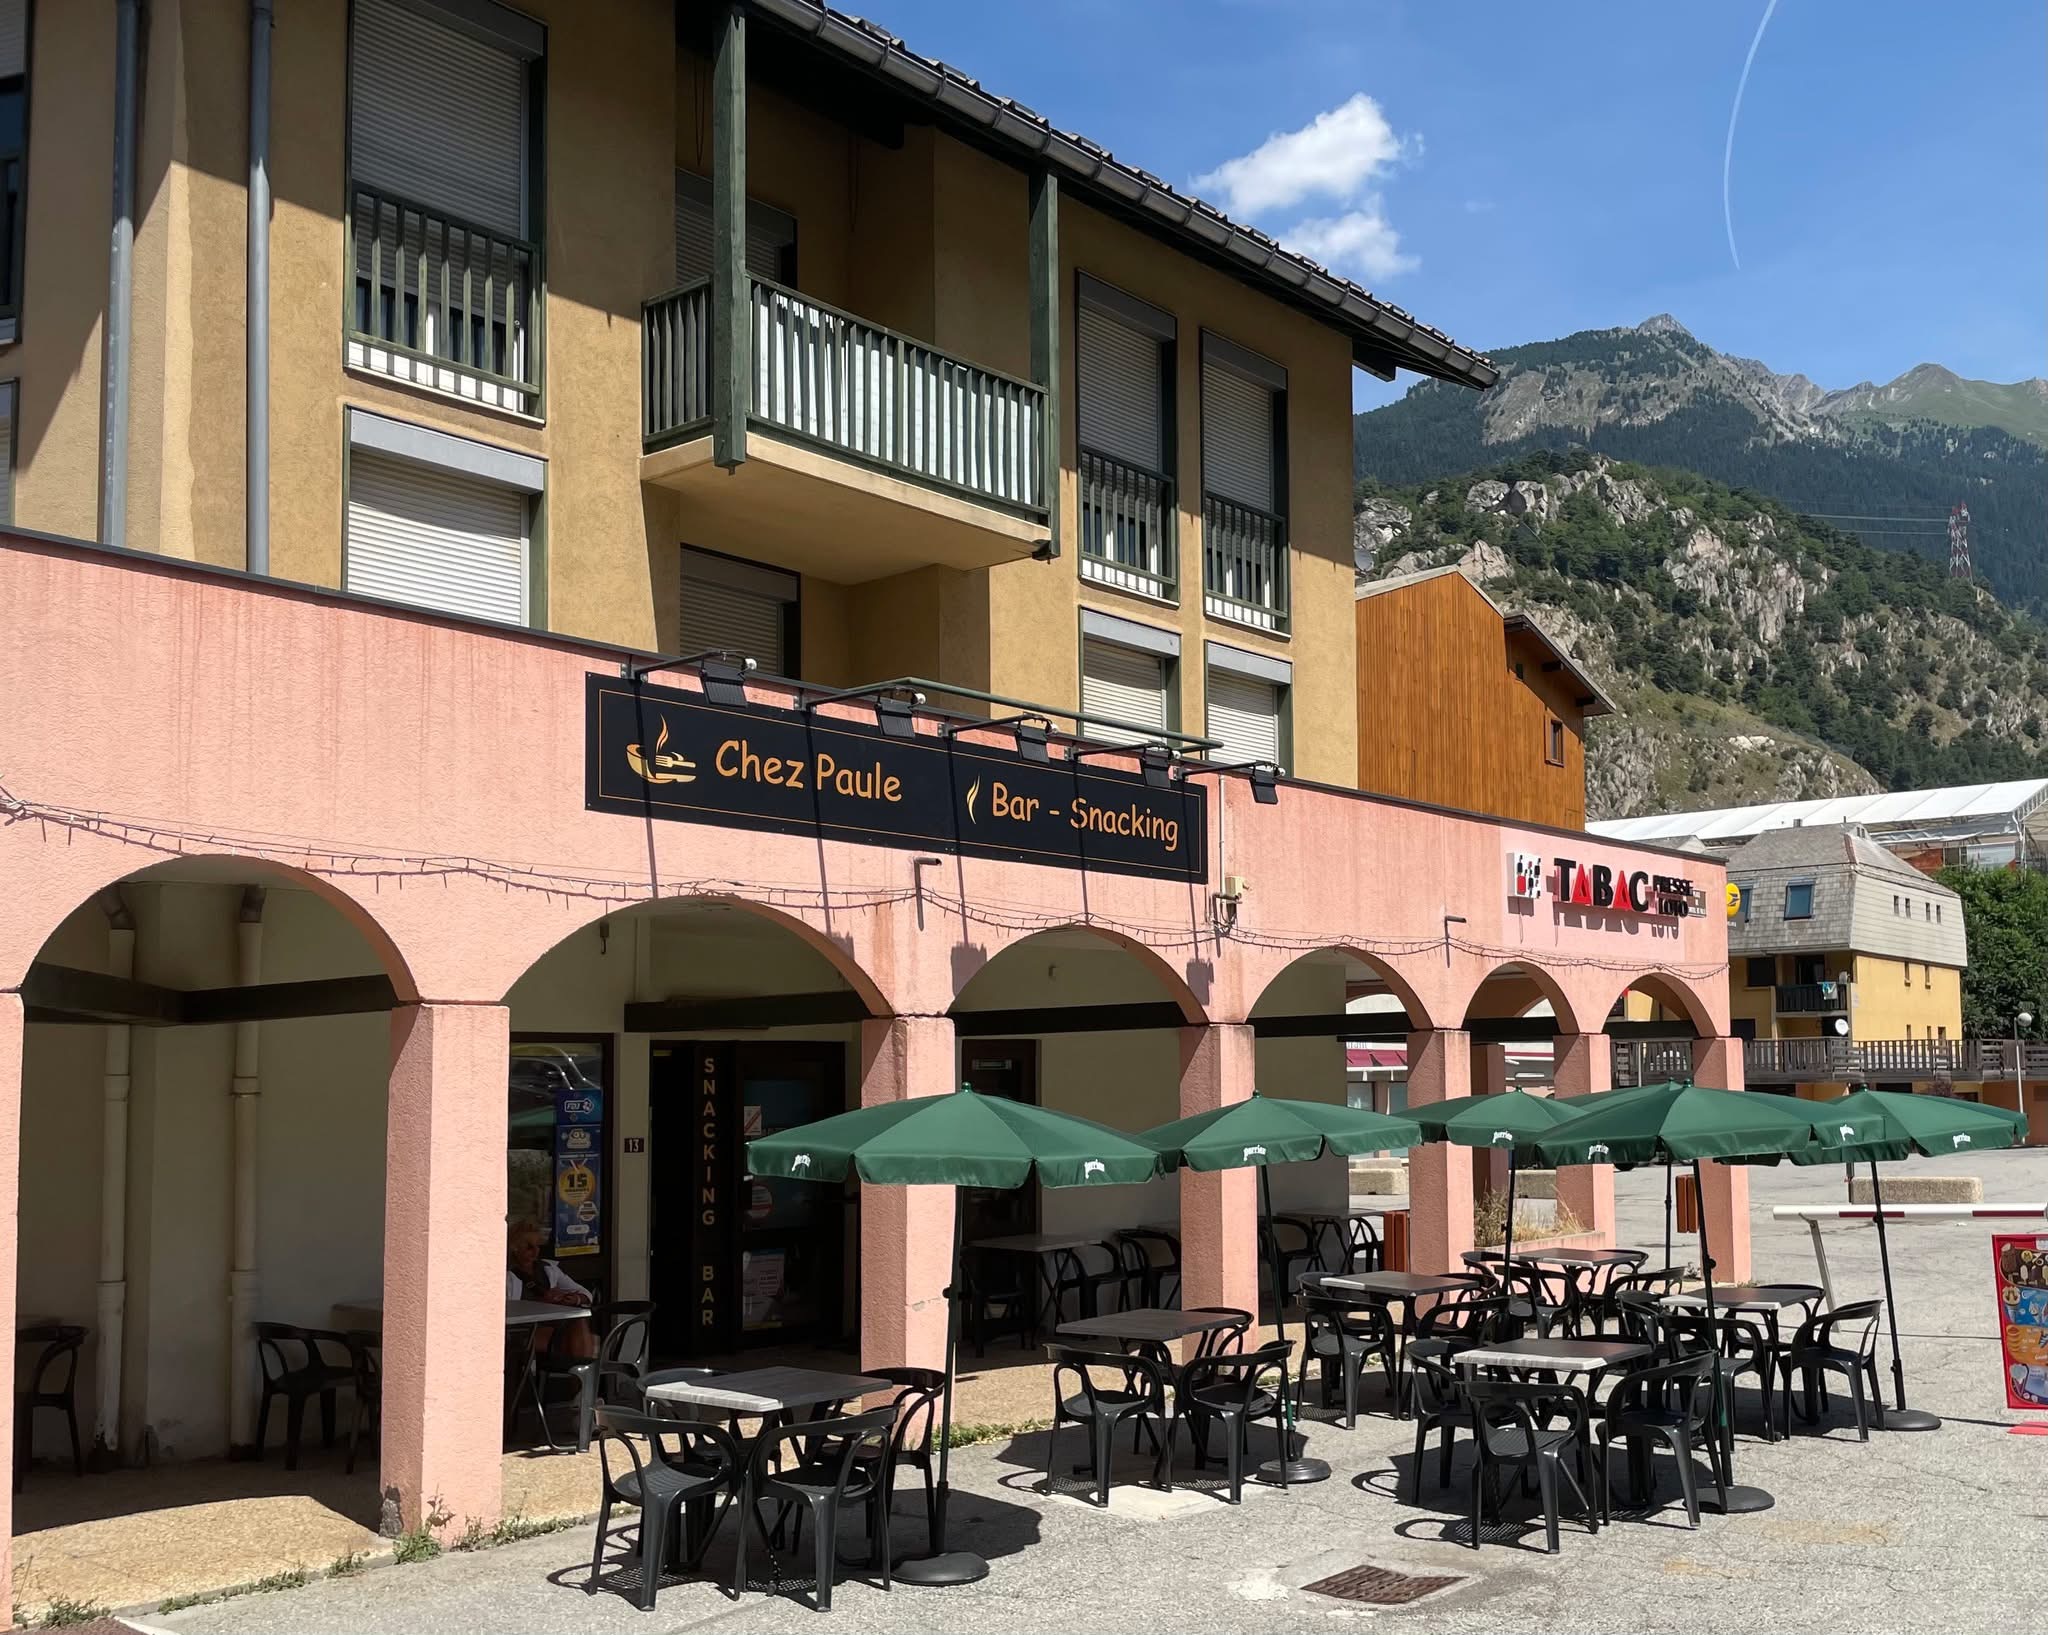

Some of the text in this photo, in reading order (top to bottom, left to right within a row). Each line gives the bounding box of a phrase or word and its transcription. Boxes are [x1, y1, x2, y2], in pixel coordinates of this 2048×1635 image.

[716, 739, 902, 802] Chez Paule
[992, 782, 1039, 822] Bar
[1070, 797, 1178, 852] Snacking
[1554, 858, 1649, 912] TABAC
[1653, 875, 1693, 896] PRESSE
[628, 1138, 640, 1152] 13
[702, 1058, 716, 1225] SNACKING
[701, 1265, 715, 1325] BAR
